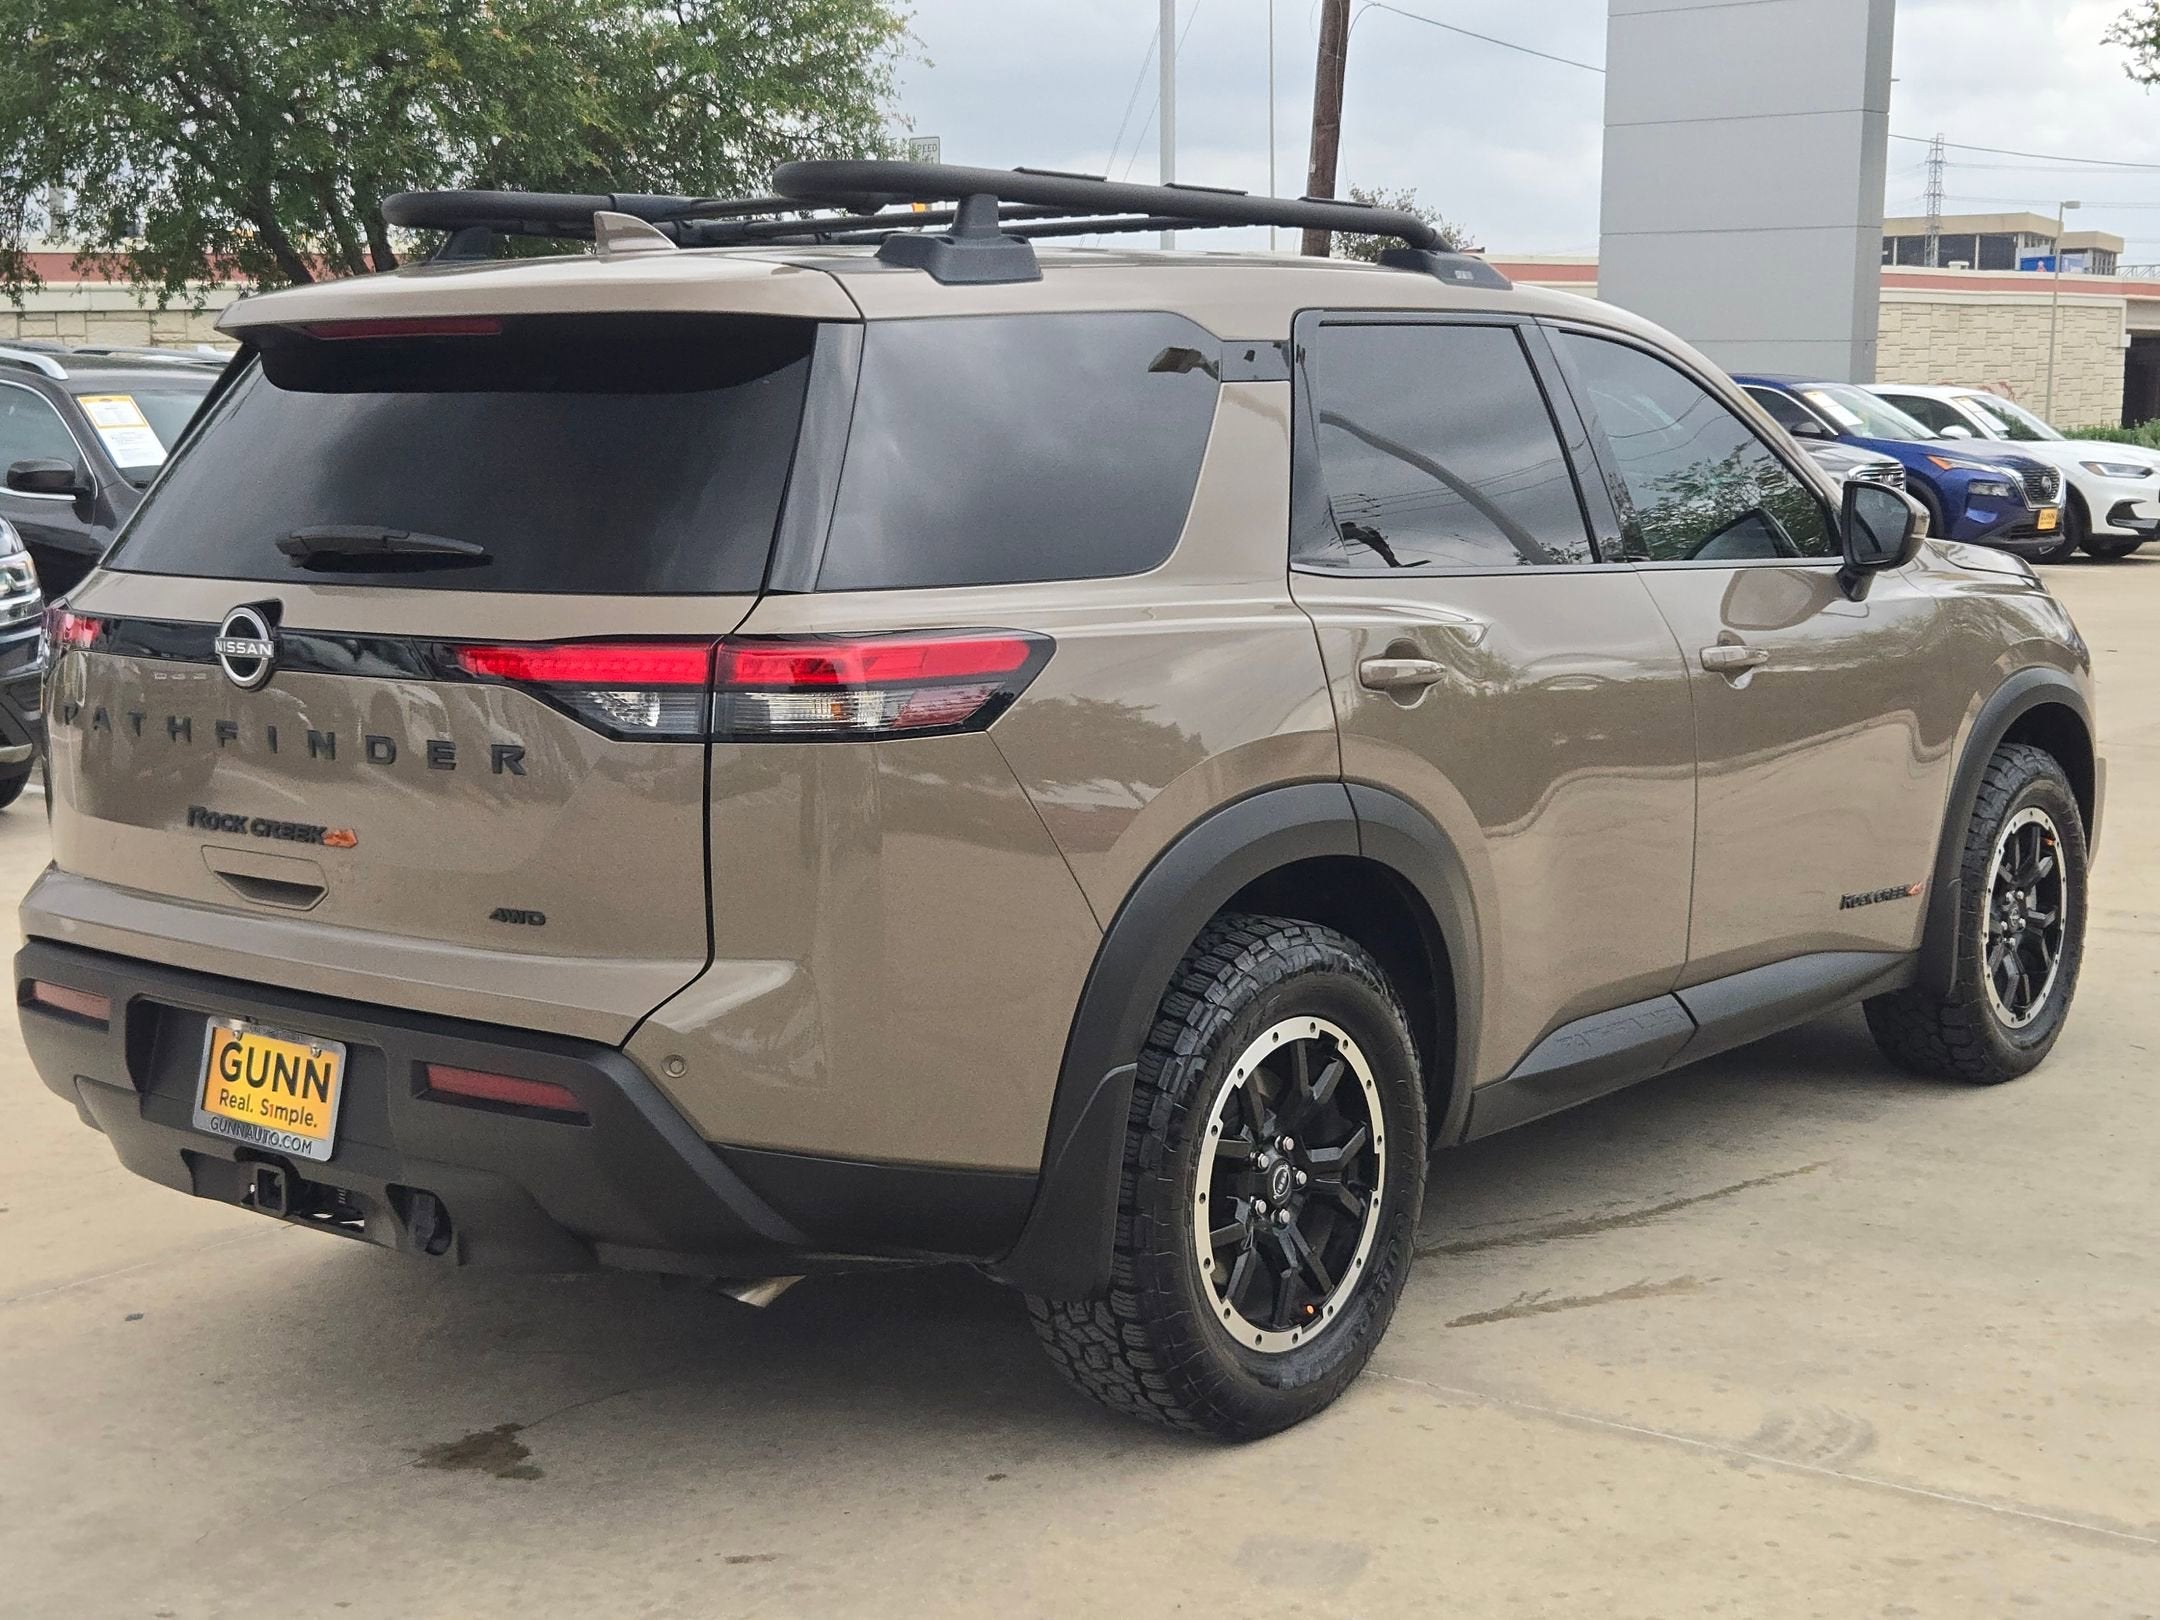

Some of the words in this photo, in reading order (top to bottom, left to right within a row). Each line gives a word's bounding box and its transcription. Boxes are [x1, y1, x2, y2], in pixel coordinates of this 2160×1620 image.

[215, 639, 272, 656] NISSAN
[63, 703, 527, 777] PATHFINDER
[489, 907, 546, 926] 4WD
[219, 1041, 332, 1103] GUNN
[219, 1088, 254, 1113] Real.
[210, 1116, 313, 1154] GUNNAUTO.COM
